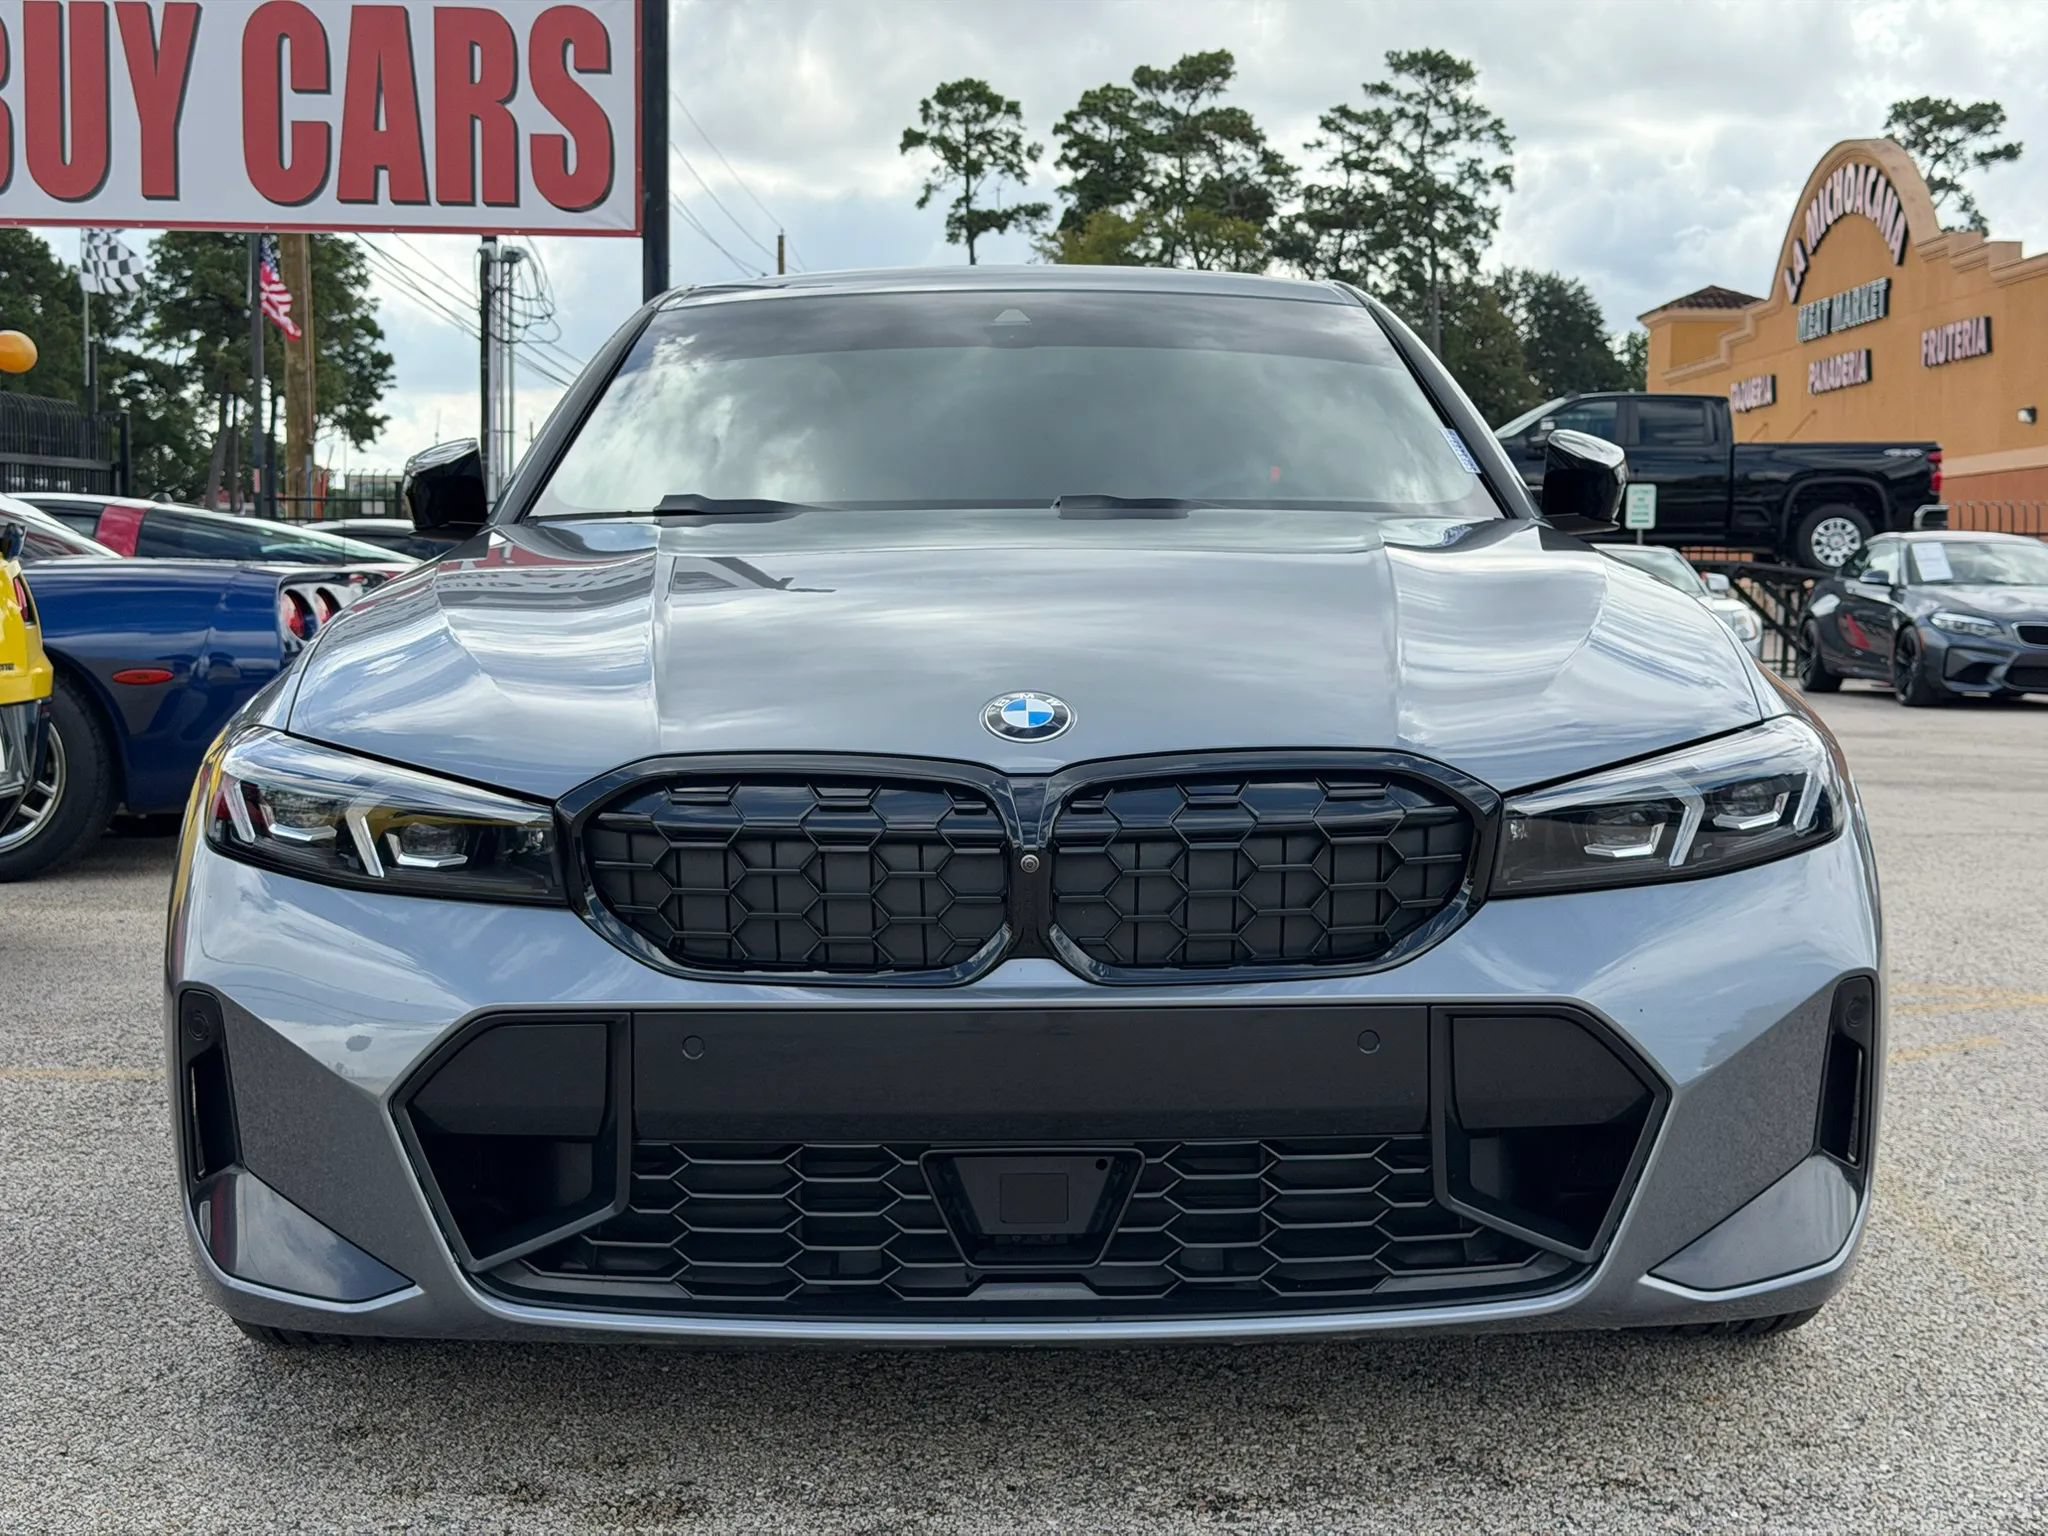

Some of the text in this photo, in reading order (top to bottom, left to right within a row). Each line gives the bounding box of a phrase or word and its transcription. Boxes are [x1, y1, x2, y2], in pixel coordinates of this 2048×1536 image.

[0, 0, 614, 213] UY CARS
[1784, 162, 1908, 304] LA MICHOACANA
[1798, 277, 1891, 342] MEAT MARKET
[1921, 315, 1992, 367] FRUTERIA
[1808, 349, 1871, 395] PANADERIA
[994, 692, 1062, 707] BMW
